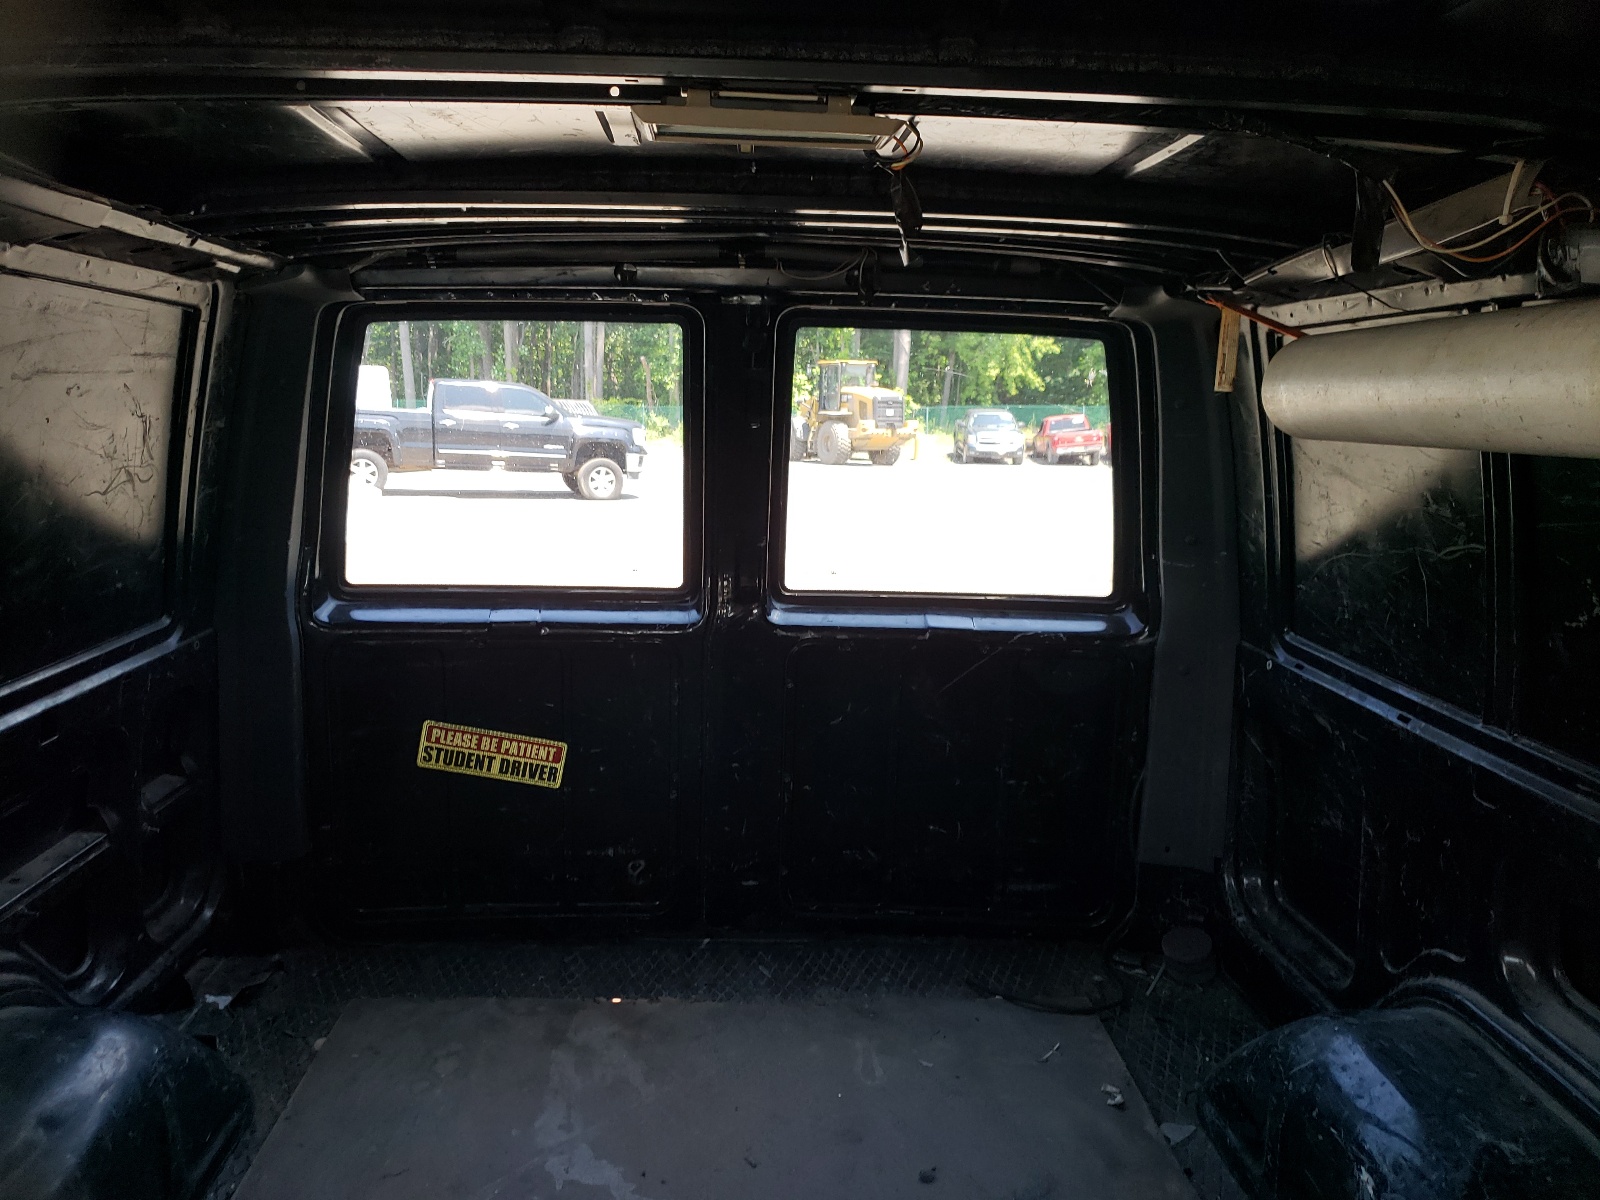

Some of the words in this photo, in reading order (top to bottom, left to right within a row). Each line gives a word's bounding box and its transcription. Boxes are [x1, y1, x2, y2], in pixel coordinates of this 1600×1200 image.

[431, 728, 479, 749] PLEASE
[480, 736, 499, 752] BE
[501, 739, 557, 761] PATIENT
[423, 746, 496, 772] STUDENT
[499, 758, 559, 783] DRIVER
